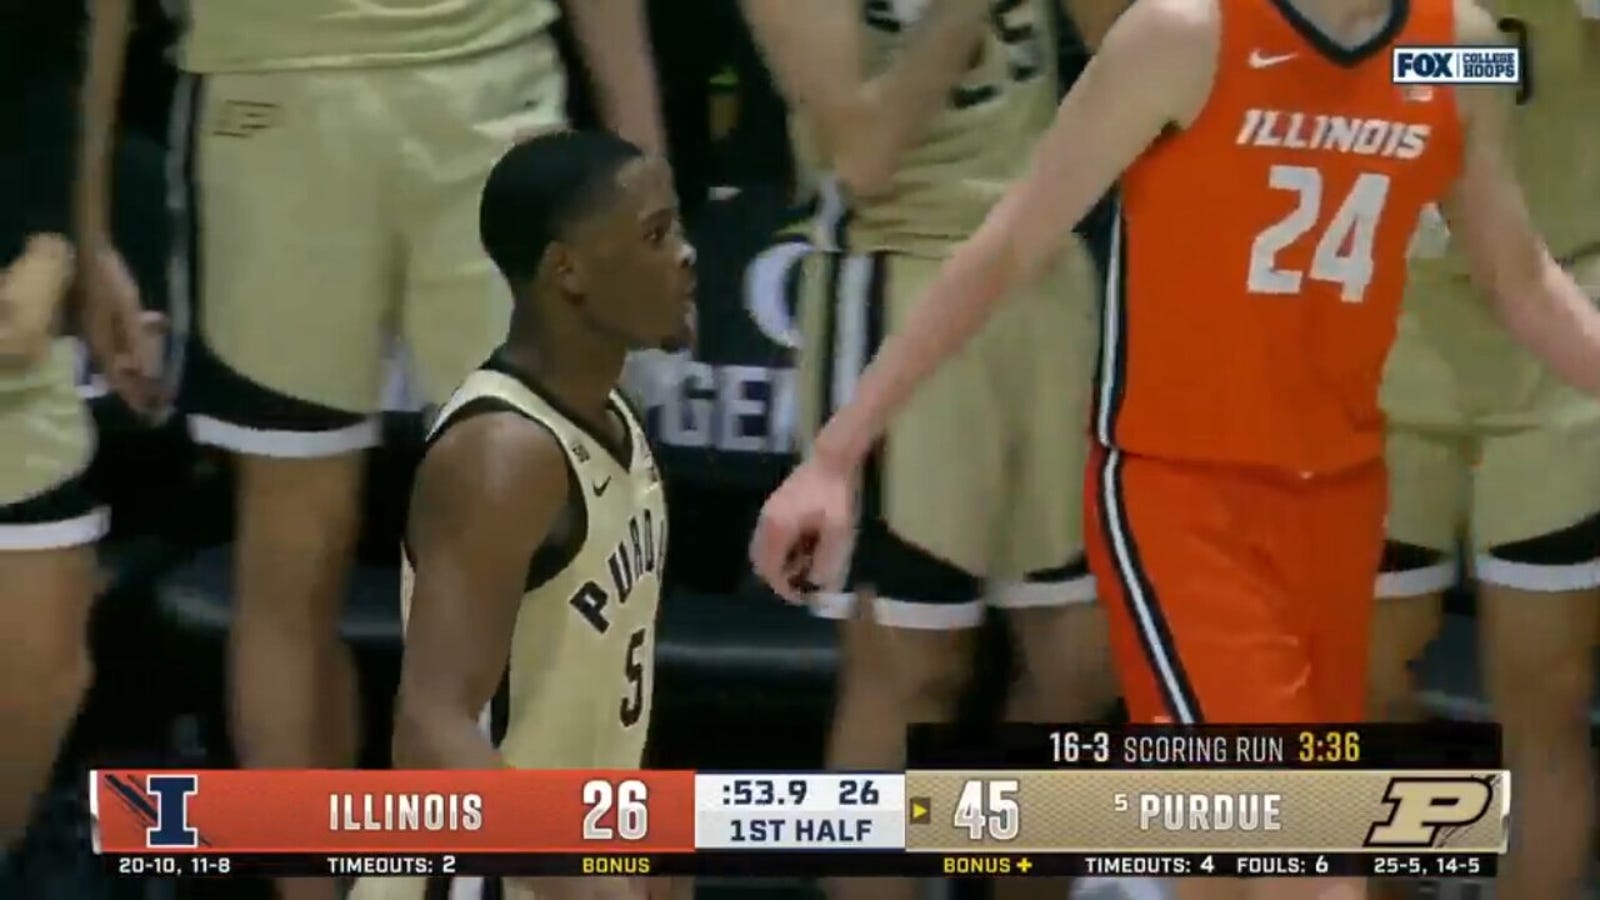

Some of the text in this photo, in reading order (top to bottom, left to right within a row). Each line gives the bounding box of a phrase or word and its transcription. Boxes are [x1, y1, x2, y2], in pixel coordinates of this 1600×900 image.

[1236, 109, 1431, 160] ILLINOIS
[1247, 165, 1391, 303] 24
[620, 628, 646, 727] 5
